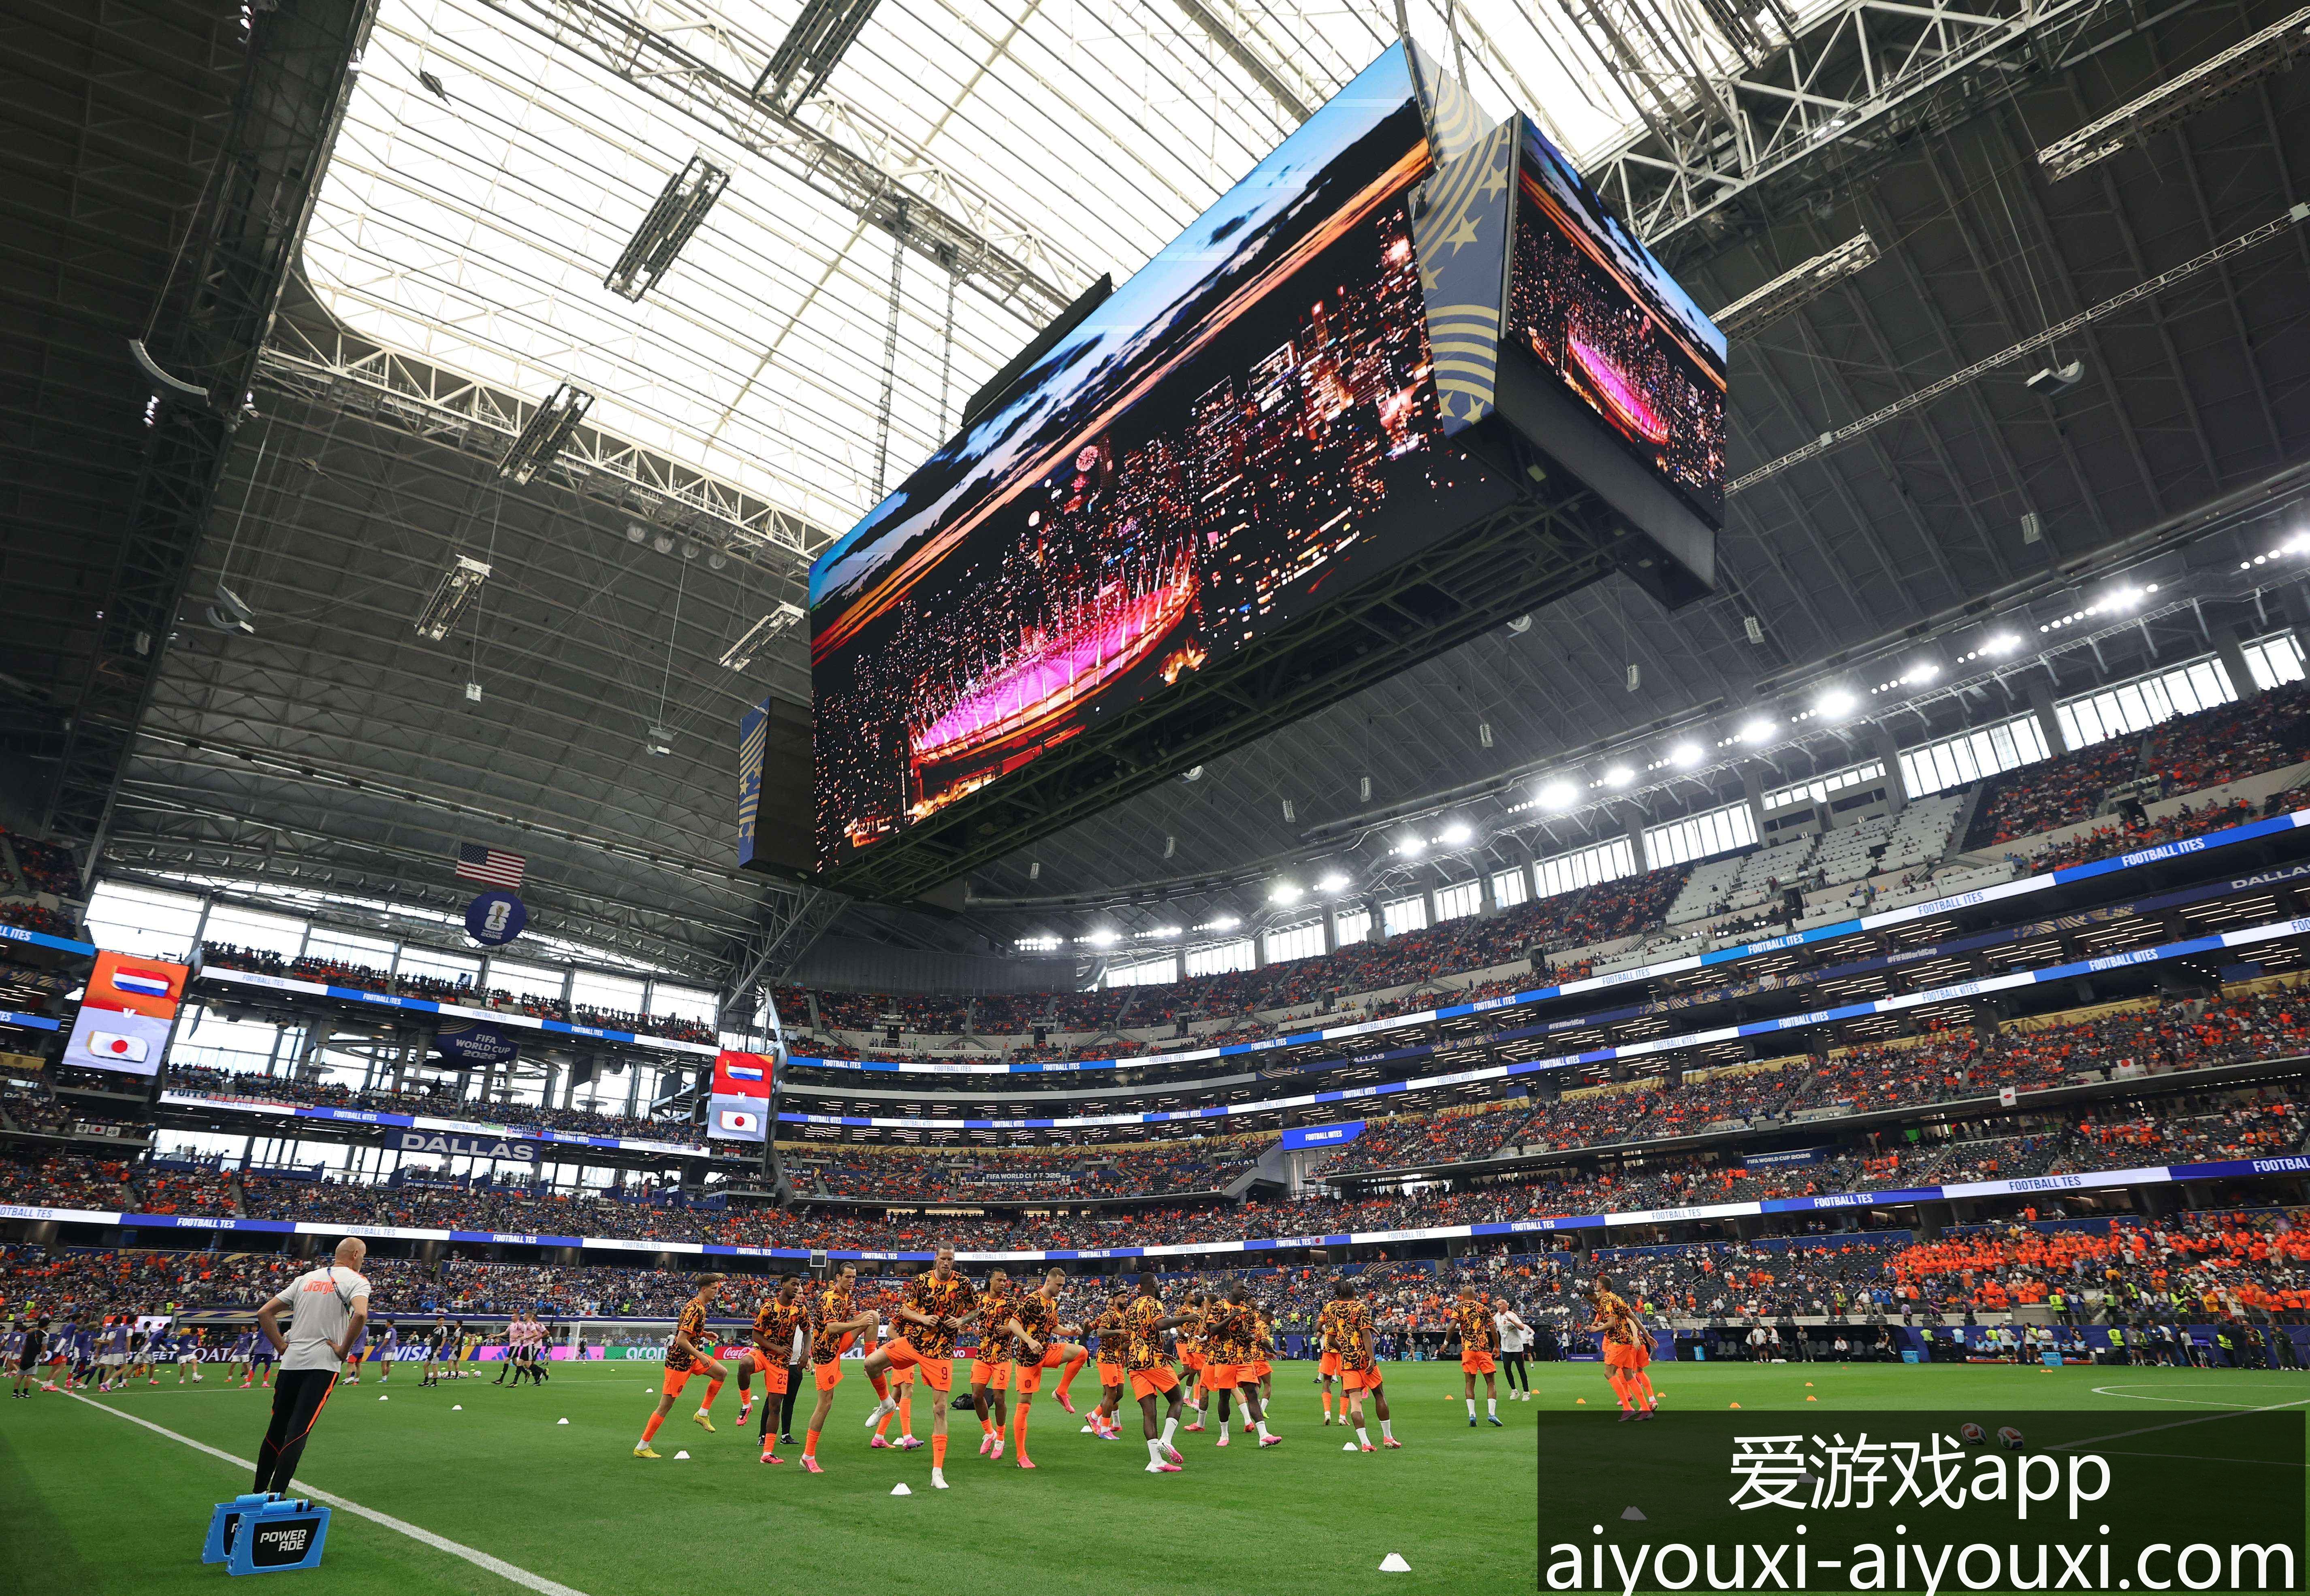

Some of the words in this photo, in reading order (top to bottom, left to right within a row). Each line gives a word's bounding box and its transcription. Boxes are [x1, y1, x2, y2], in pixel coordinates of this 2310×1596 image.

[2122, 845, 2178, 867] FOOTBALL
[2178, 838, 2205, 853] ITES
[1918, 898, 1962, 915] FOOTBALL
[1964, 892, 1984, 905] ITES
[1748, 940, 1785, 955] FOOTBALL
[1786, 933, 1804, 946] ITES
[1887, 948, 1937, 963] #FIFAWorldCup
[2088, 954, 2134, 971] FOOTBALL
[242, 974, 271, 984] FOOTBALL
[1602, 973, 1634, 985] FOOTBALL
[1635, 968, 1650, 978] ITES
[363, 993, 389, 1004] FOOTBALL
[1922, 988, 1959, 1001] FOOTBALL
[1473, 999, 1502, 1011] FOOTBALL
[472, 1010, 495, 1020] FOOTBALL
[1358, 1021, 1382, 1031] FOOTBALL
[1549, 1018, 1585, 1030] #FIFAWorldCup
[1779, 1015, 1810, 1029] FOOTBALL
[571, 1026, 592, 1036] FOOTBALL
[475, 1034, 497, 1044] FIFA
[1653, 1038, 1681, 1050] FOOTBALL
[456, 1039, 491, 1052] WORLD
[493, 1045, 511, 1054] CUP
[662, 1041, 682, 1049] FOOTBALL
[1251, 1040, 1275, 1050] FOOTBALL
[462, 1049, 497, 1060] 2026
[1149, 1055, 1173, 1063] FOOTBALL
[1353, 1053, 1384, 1063] ALLAS
[823, 1059, 849, 1068] FOOTBALL
[1540, 1058, 1565, 1069] FOOTBALL
[1437, 1075, 1460, 1084] FOOTBALL
[1342, 1089, 1364, 1098] FOOTBALL
[333, 1110, 361, 1120] FOOTBALL
[553, 1134, 576, 1142] FOOTBALL
[1305, 1132, 1328, 1141] FOOTBALL
[401, 1134, 534, 1160] DALLAS
[2252, 1157, 2310, 1172] FOOTBAL
[2009, 1178, 2060, 1191] FOOTBALL
[2063, 1176, 2081, 1187] TES
[1814, 1195, 1856, 1208] FOOTBALL
[1858, 1193, 1873, 1204] TES
[36, 1209, 52, 1218] TES
[1652, 1210, 1687, 1220] FOOTBALL
[1688, 1208, 1701, 1217] TES
[177, 1217, 218, 1227] FOOTBALL
[219, 1219, 236, 1229] TES
[1511, 1221, 1541, 1232] FOOTBALL
[1542, 1220, 1555, 1229] TES
[346, 1227, 382, 1235] FOOTBALL
[1388, 1232, 1414, 1240] FOOTBALL
[493, 1234, 524, 1243] FOOTBALL
[1276, 1239, 1300, 1247] FOOTBALL
[393, 1346, 431, 1361] VISA
[941, 1367, 948, 1380] 9
[1000, 1370, 1005, 1381] 5
[260, 1529, 307, 1543] POWER
[278, 1539, 305, 1551] ADE
